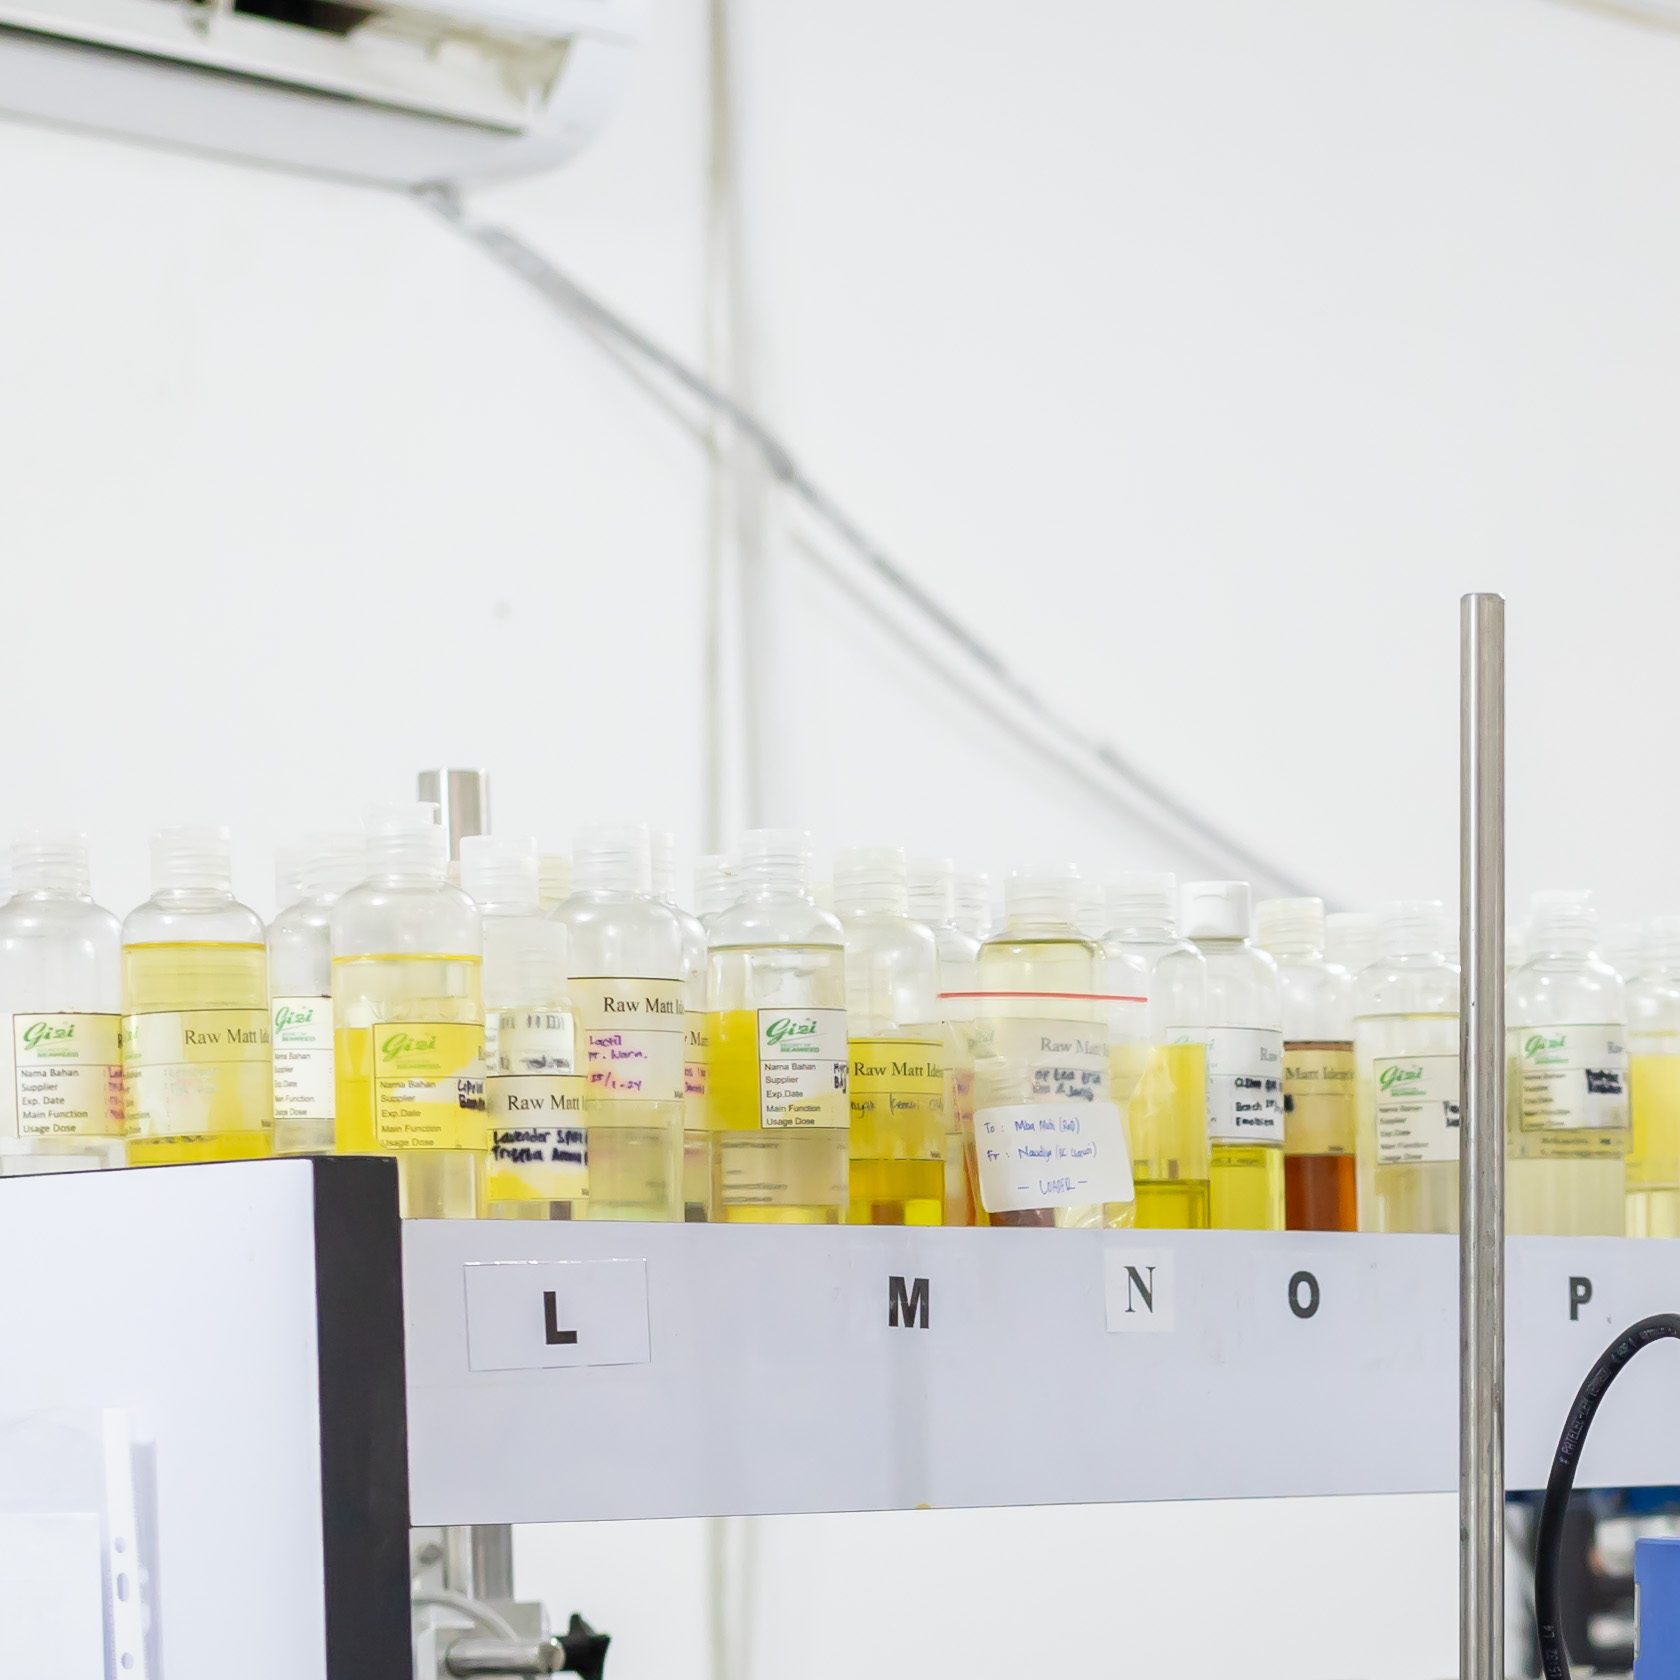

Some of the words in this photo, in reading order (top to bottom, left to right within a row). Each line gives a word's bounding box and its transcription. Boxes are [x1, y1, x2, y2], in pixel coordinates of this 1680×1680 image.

[602, 996, 640, 1013] Raw
[645, 997, 674, 1014] Matt
[23, 1021, 75, 1050] Gizi
[184, 1029, 221, 1045] Raw
[227, 1027, 257, 1044] Matt
[766, 1017, 817, 1046] Gizi
[382, 1032, 437, 1062] Gizi
[764, 1063, 790, 1072] Nama
[792, 1062, 816, 1072] Bahan
[854, 1062, 886, 1077] Raw
[891, 1062, 923, 1077] Matt
[21, 1069, 46, 1078] Nama
[49, 1069, 79, 1078] Bahan
[408, 1081, 436, 1089] Bahan
[765, 1076, 799, 1085] Supplier
[21, 1082, 58, 1092] Supplier
[43, 1096, 65, 1105] Date
[381, 1094, 416, 1104] Supplier
[507, 1094, 544, 1111] Raw
[550, 1094, 580, 1111] Matt
[22, 1110, 46, 1119] Main
[48, 1109, 88, 1119] Function
[766, 1104, 787, 1113] Main
[789, 1104, 821, 1113] Function
[766, 1117, 793, 1127] Usage
[795, 1117, 815, 1126] Dose
[984, 1122, 995, 1134] To
[23, 1124, 50, 1135] Usage
[53, 1123, 77, 1133] Dose
[404, 1124, 442, 1133] Function
[1118, 1264, 1158, 1314] N
[1286, 1269, 1322, 1321] O
[887, 1274, 931, 1331] M
[1567, 1275, 1594, 1323] P
[542, 1289, 579, 1347] L
